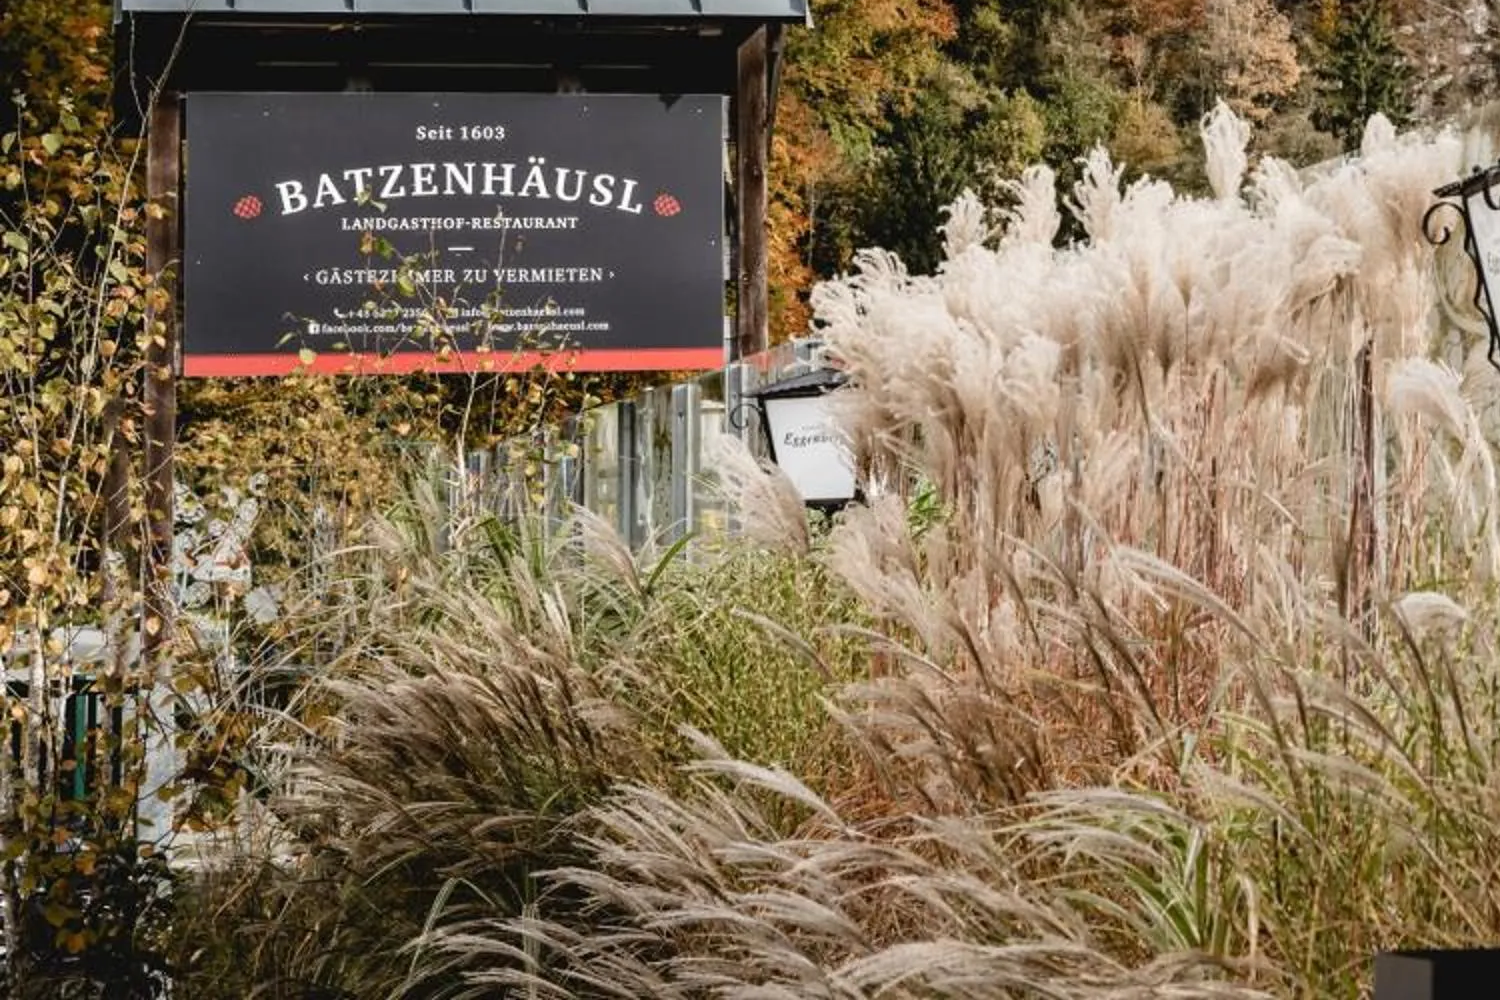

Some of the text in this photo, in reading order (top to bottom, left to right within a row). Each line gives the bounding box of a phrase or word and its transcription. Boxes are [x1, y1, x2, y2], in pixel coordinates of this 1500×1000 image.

[415, 126, 505, 140] Seit 1603
[275, 156, 643, 215] BATZENHÄUSL
[341, 217, 579, 231] LANDGASTHOF-RESTAURANT
[463, 268, 487, 283] ZU
[493, 267, 602, 283] VERMIETEN
